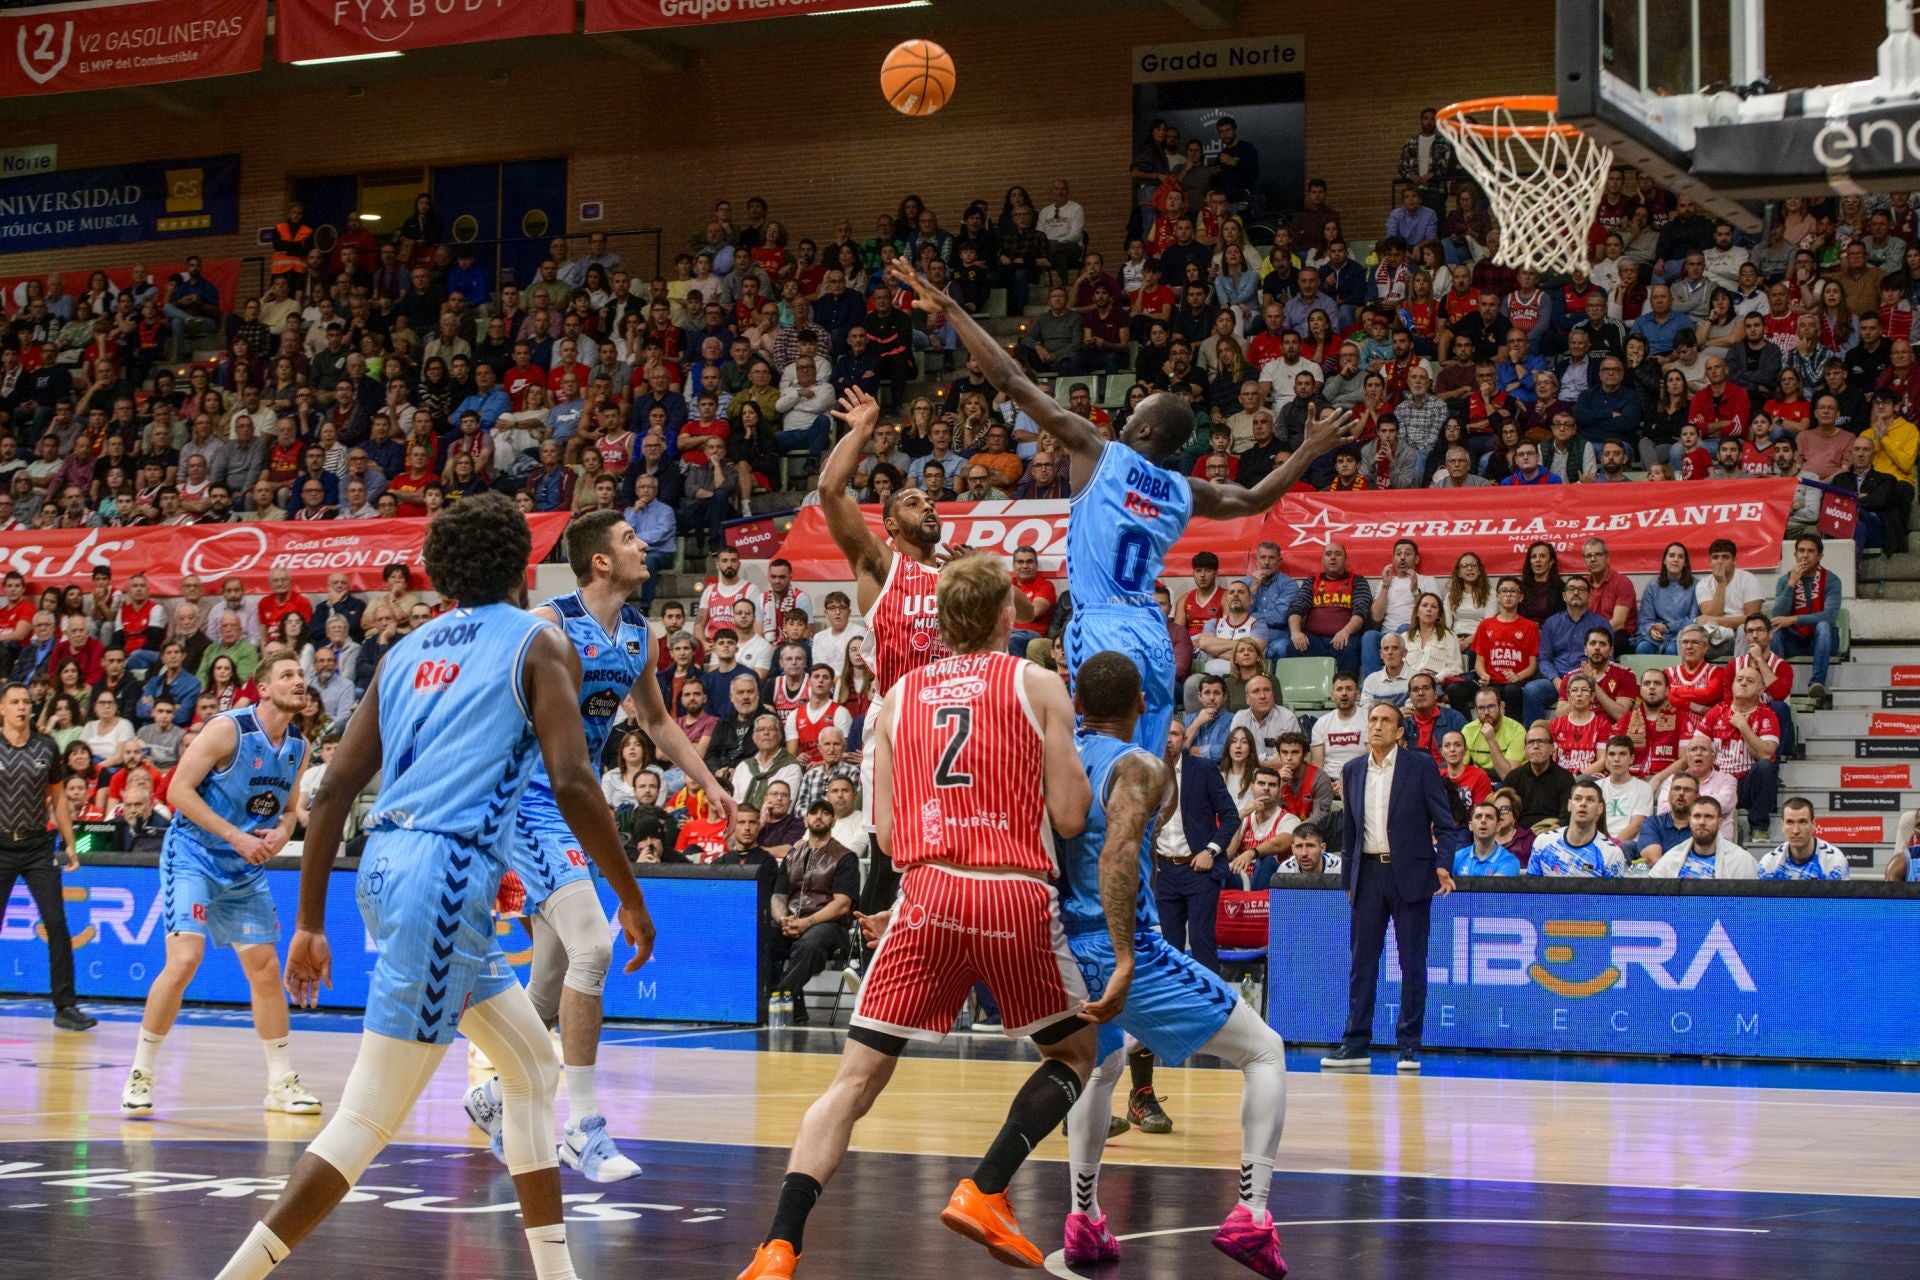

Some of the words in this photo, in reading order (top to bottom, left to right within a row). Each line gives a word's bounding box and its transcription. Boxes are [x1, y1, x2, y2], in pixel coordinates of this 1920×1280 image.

[79, 34, 100, 52] V2
[105, 16, 242, 50] GASOLINERAS
[79, 61, 90, 73] El
[91, 59, 113, 71] MVP
[115, 55, 131, 69] del
[135, 51, 199, 67] Combustible
[1141, 51, 1217, 72] Grada
[1229, 44, 1296, 66] Norte
[0, 221, 52, 238] TÓLICA
[56, 220, 75, 234] DE
[80, 214, 138, 232] MURCIA
[1126, 467, 1170, 501] DIBBA
[1124, 491, 1160, 519] Río
[1825, 506, 1853, 521] MÓDULO
[1351, 517, 1547, 538] ESTRELLA
[1555, 519, 1580, 528] DE
[1582, 502, 1764, 531] LEVANTE
[1834, 521, 1840, 529] 9
[285, 540, 319, 551] Costa
[323, 536, 360, 548] Cálida
[735, 532, 772, 548] MÓDULO
[752, 545, 759, 553] 9
[1508, 533, 1562, 541] MURCIA
[271, 546, 371, 570] REGIÓN
[373, 549, 413, 567] DE
[1112, 530, 1151, 592] 0
[1313, 593, 1352, 606] UCAM
[422, 622, 484, 649] COOK
[414, 657, 461, 690] Río
[925, 656, 991, 677] RAIESTE
[584, 669, 635, 689] BREOGÁN
[933, 706, 972, 787] 2
[945, 817, 1009, 830] MURCIA
[982, 930, 1016, 939] MURCIA
[1385, 915, 1757, 998] LIBERA
[1385, 1003, 1760, 1036] TELECOM
